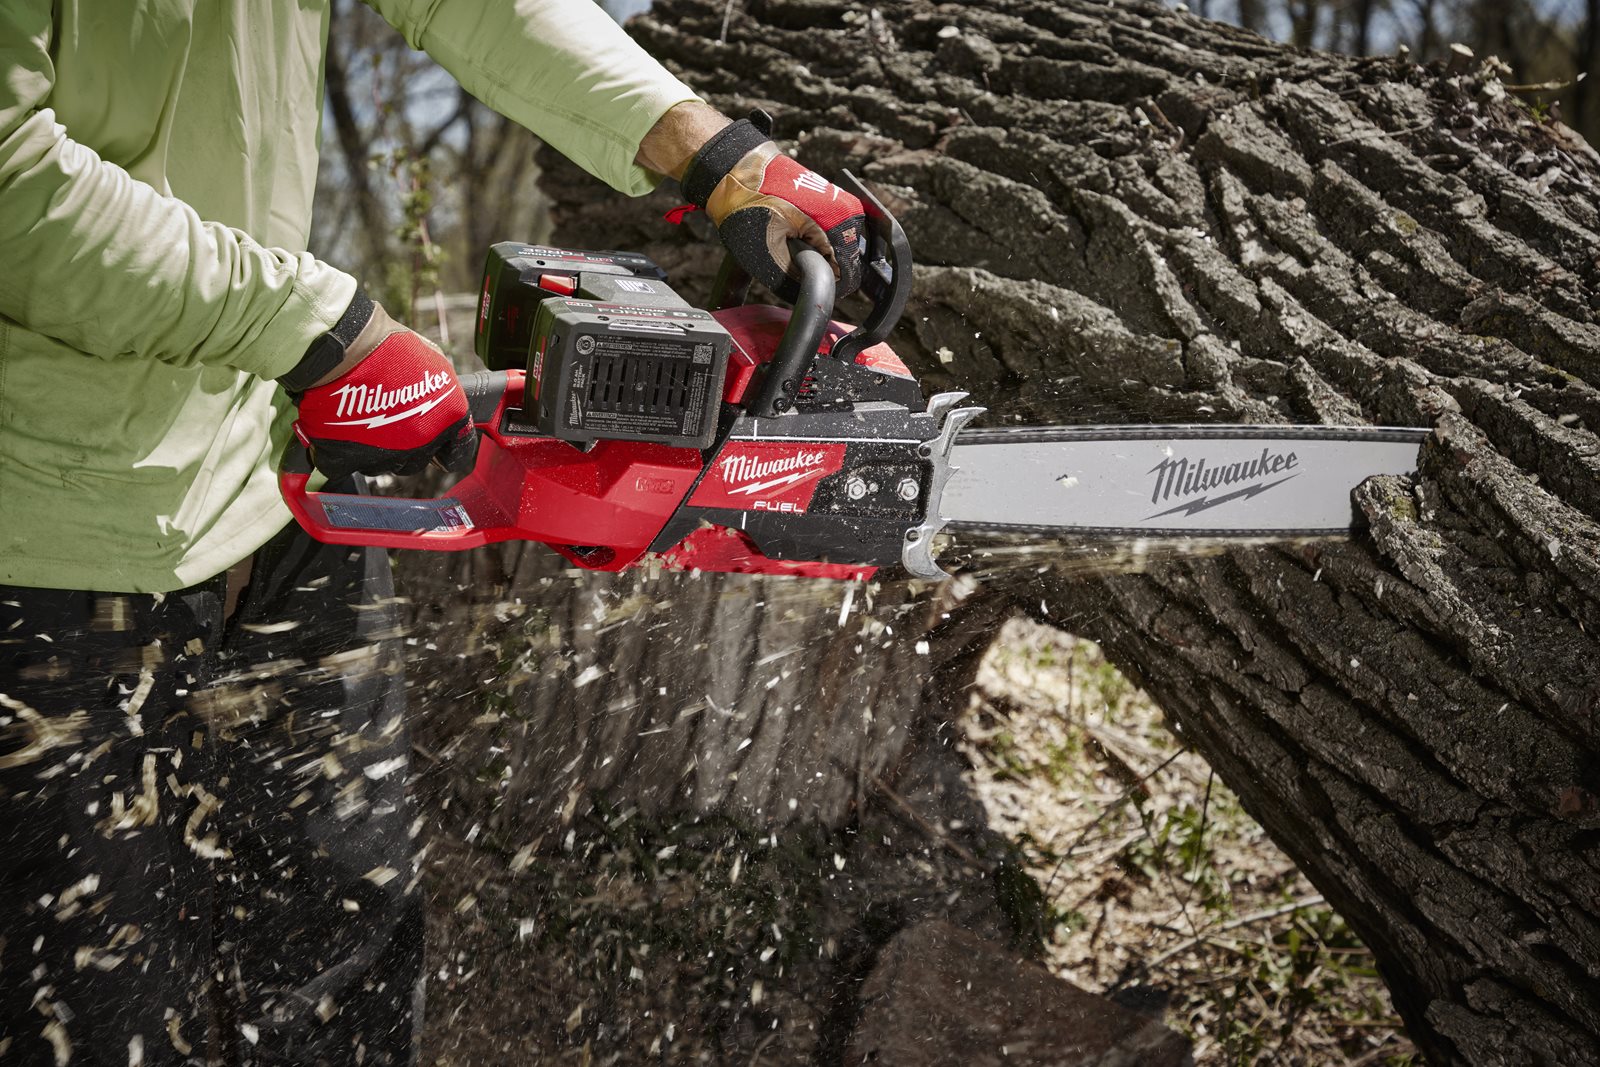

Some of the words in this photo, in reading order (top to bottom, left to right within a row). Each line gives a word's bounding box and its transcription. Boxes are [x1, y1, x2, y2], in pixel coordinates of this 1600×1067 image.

[597, 307, 666, 317] FORGE
[329, 370, 452, 418] Milwaukee
[721, 450, 825, 485] Milwaukee
[1146, 447, 1300, 505] Milwaukee
[753, 500, 804, 513] FUEL
